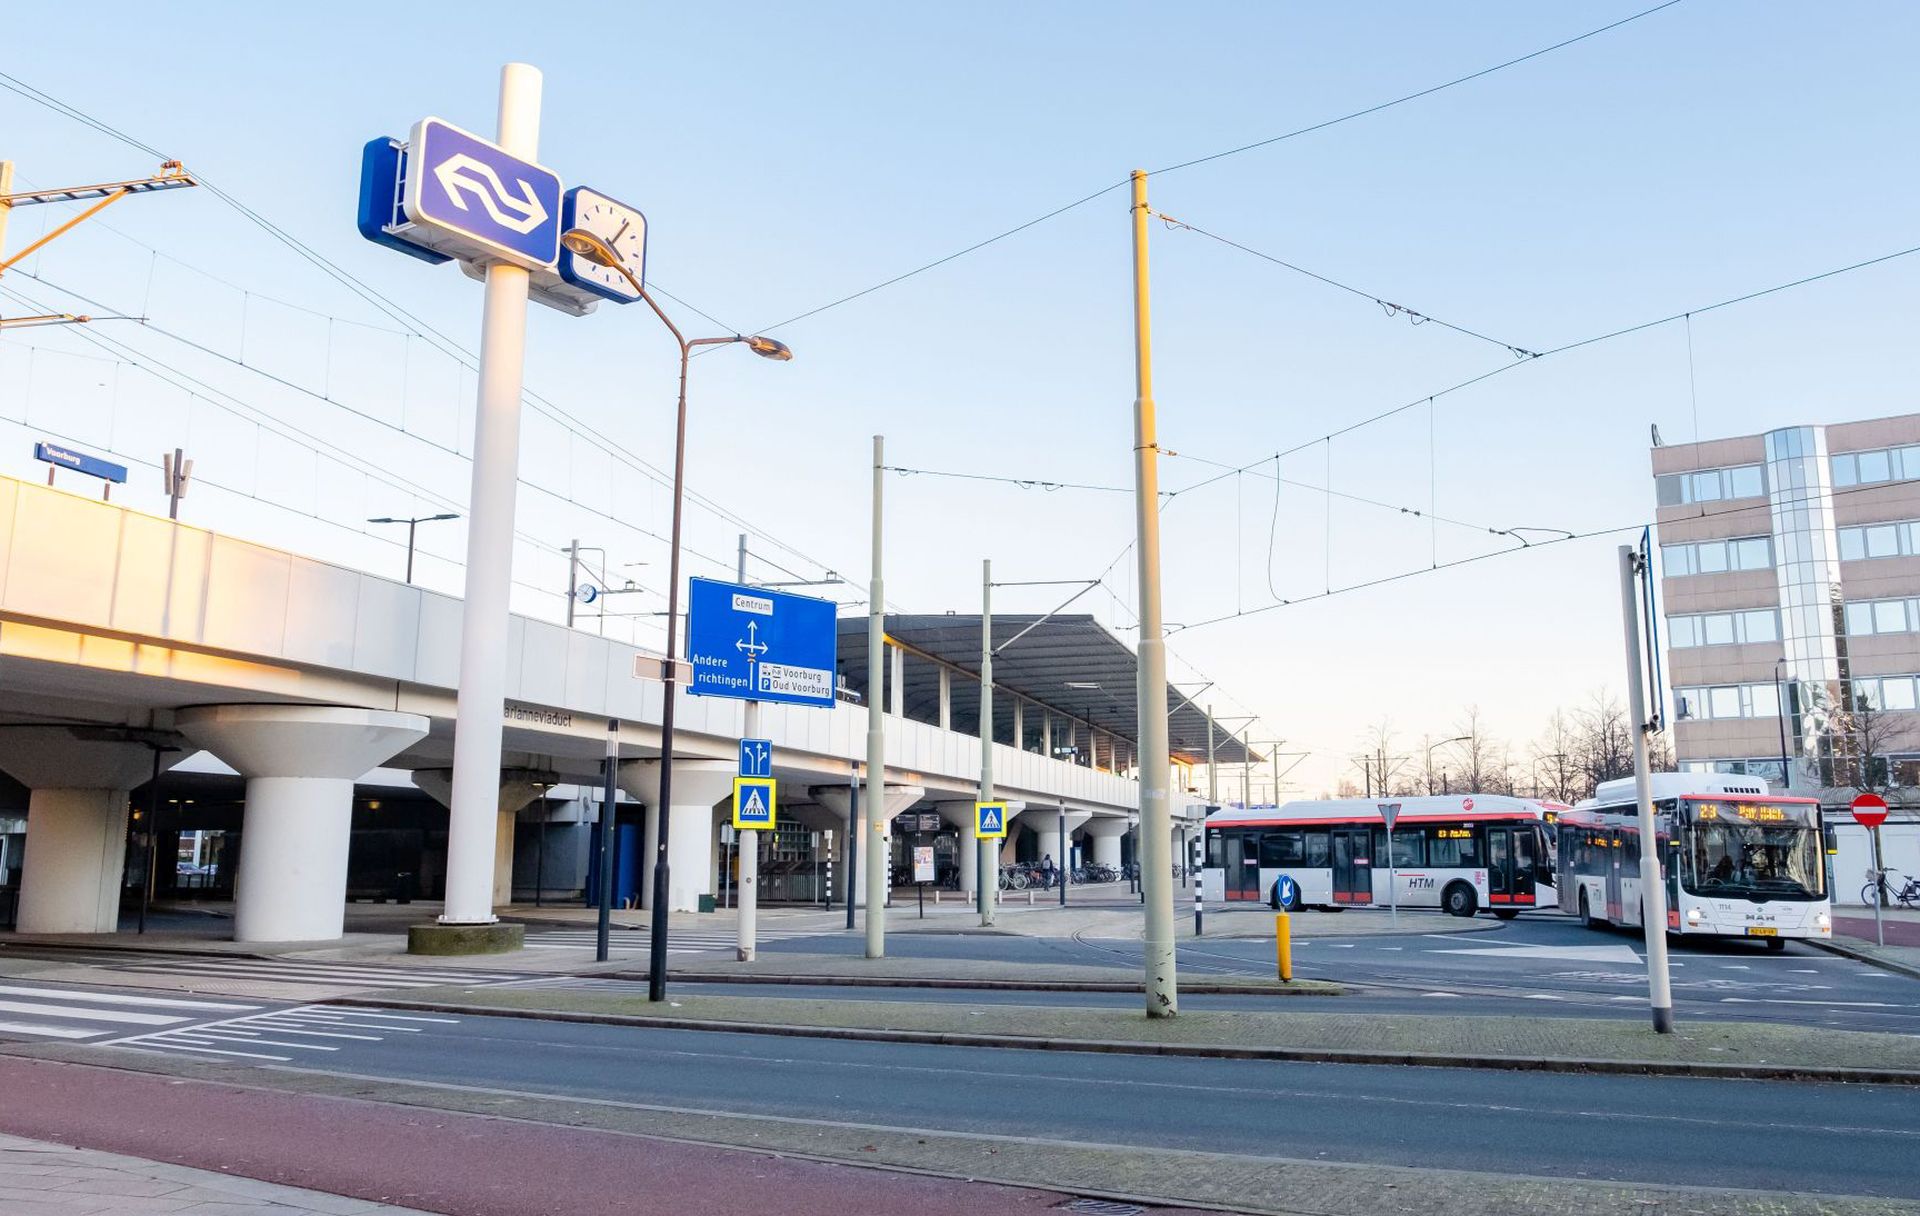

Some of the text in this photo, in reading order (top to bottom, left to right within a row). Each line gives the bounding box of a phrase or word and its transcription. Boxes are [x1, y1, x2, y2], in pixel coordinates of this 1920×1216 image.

[46, 447, 81, 466] Voorburg
[735, 597, 771, 612] Centrum
[692, 653, 728, 668] Andere
[698, 671, 748, 689] richtingen
[783, 667, 822, 683] Voorburg
[772, 680, 790, 691] Oud
[792, 682, 830, 697] Voorburg
[503, 705, 572, 728] arianneviaduct
[1700, 804, 1717, 819] 23
[1409, 878, 1435, 889] HTM
